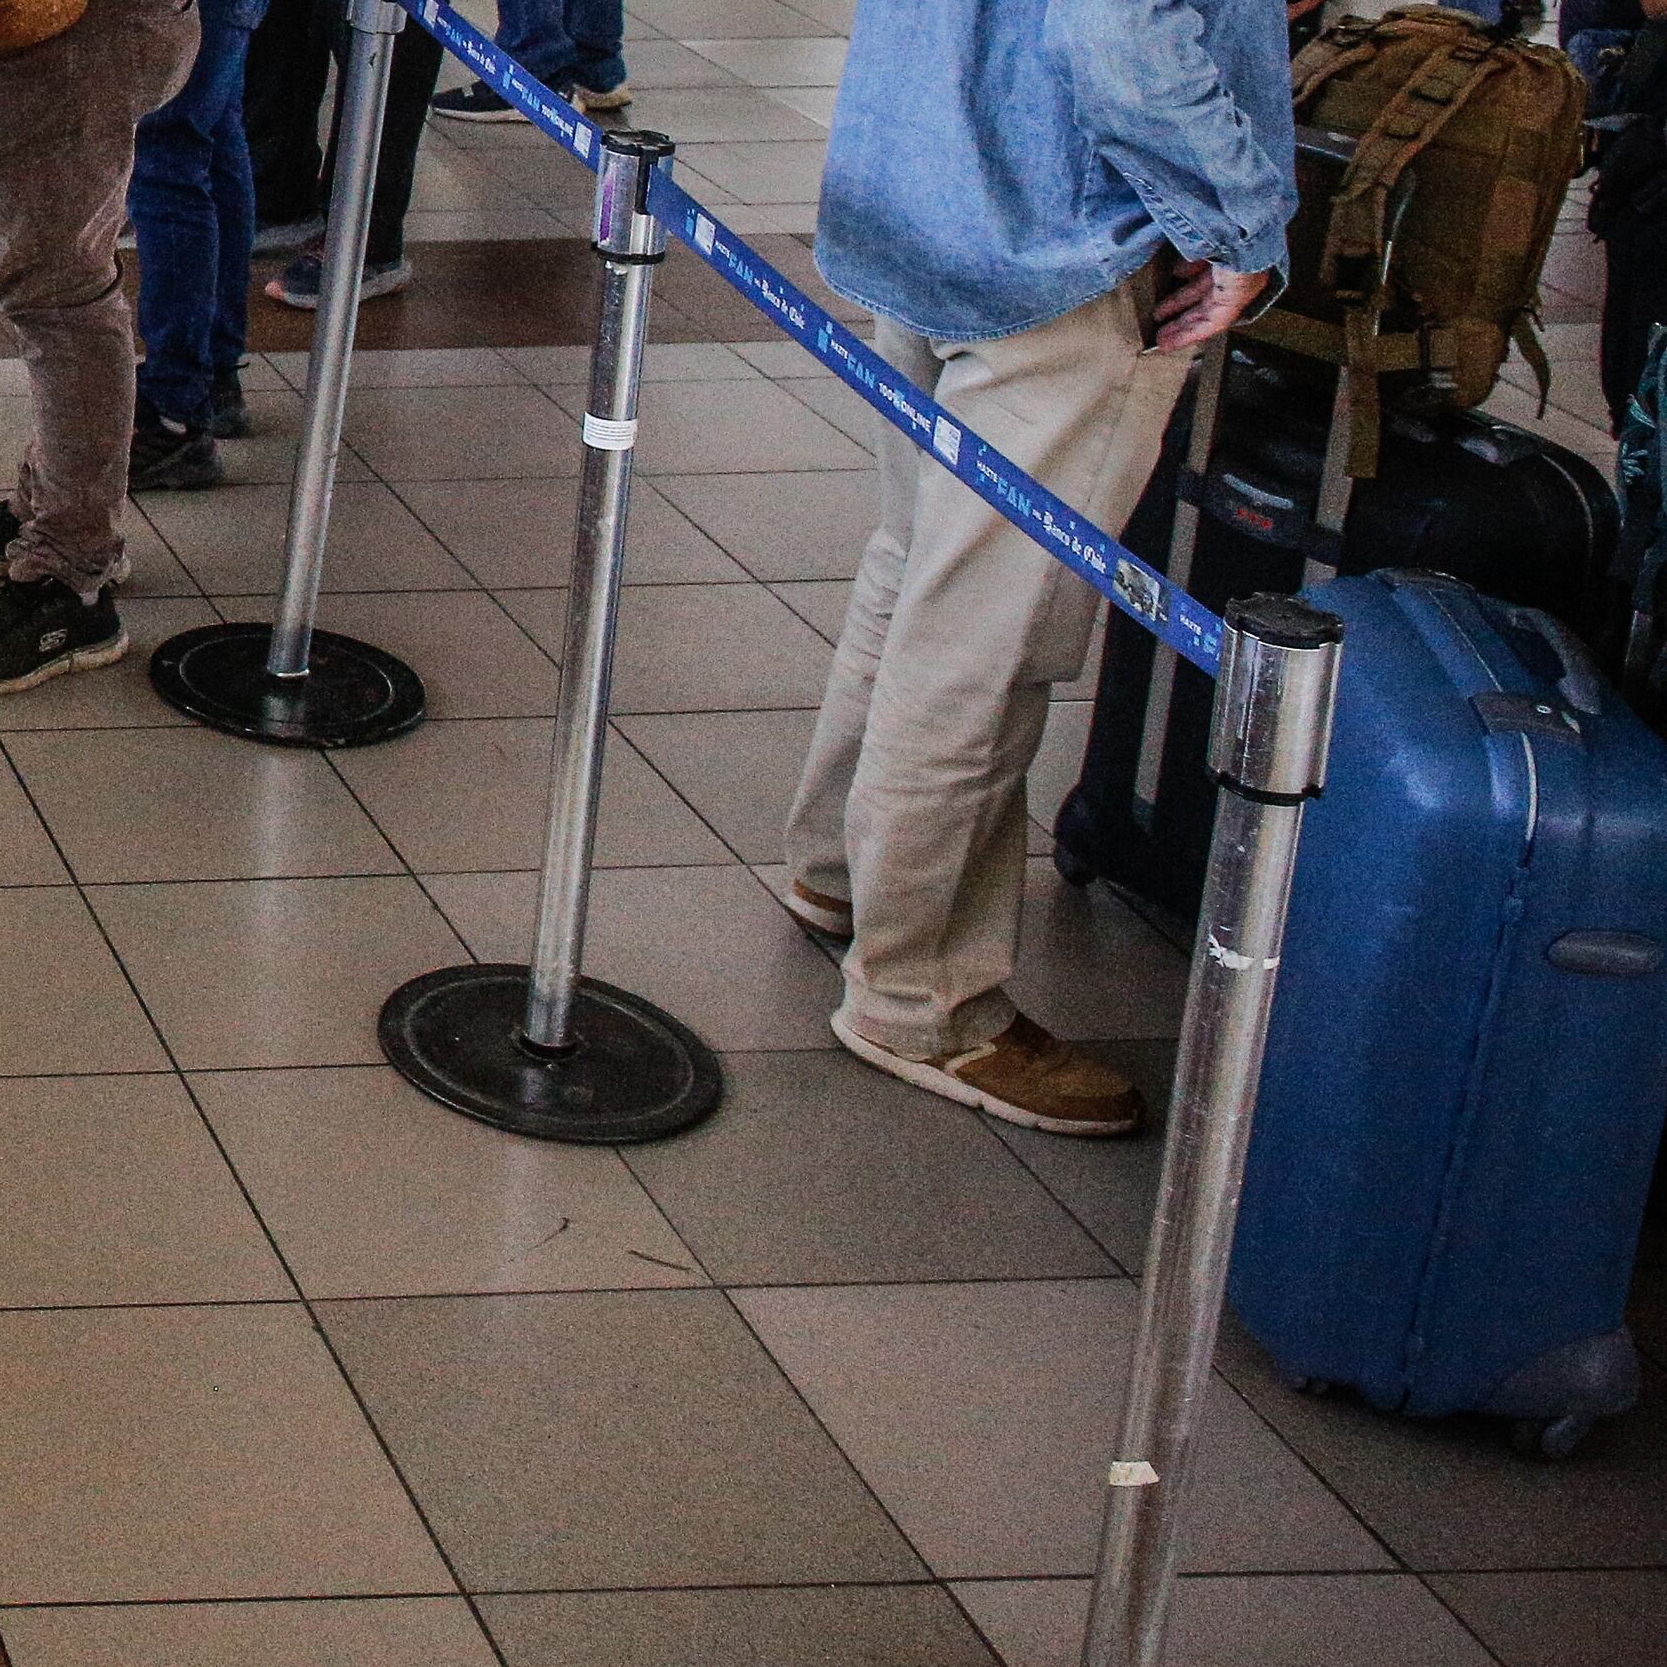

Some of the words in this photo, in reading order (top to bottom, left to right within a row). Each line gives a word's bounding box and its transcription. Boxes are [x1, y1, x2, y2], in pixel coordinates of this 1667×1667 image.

[728, 252, 754, 286] FAN
[847, 353, 876, 389] FAN
[899, 400, 932, 434] ONLINE
[976, 460, 999, 484] HAZTE
[996, 476, 1031, 518] FAN
[1179, 613, 1203, 636] HAZTE
